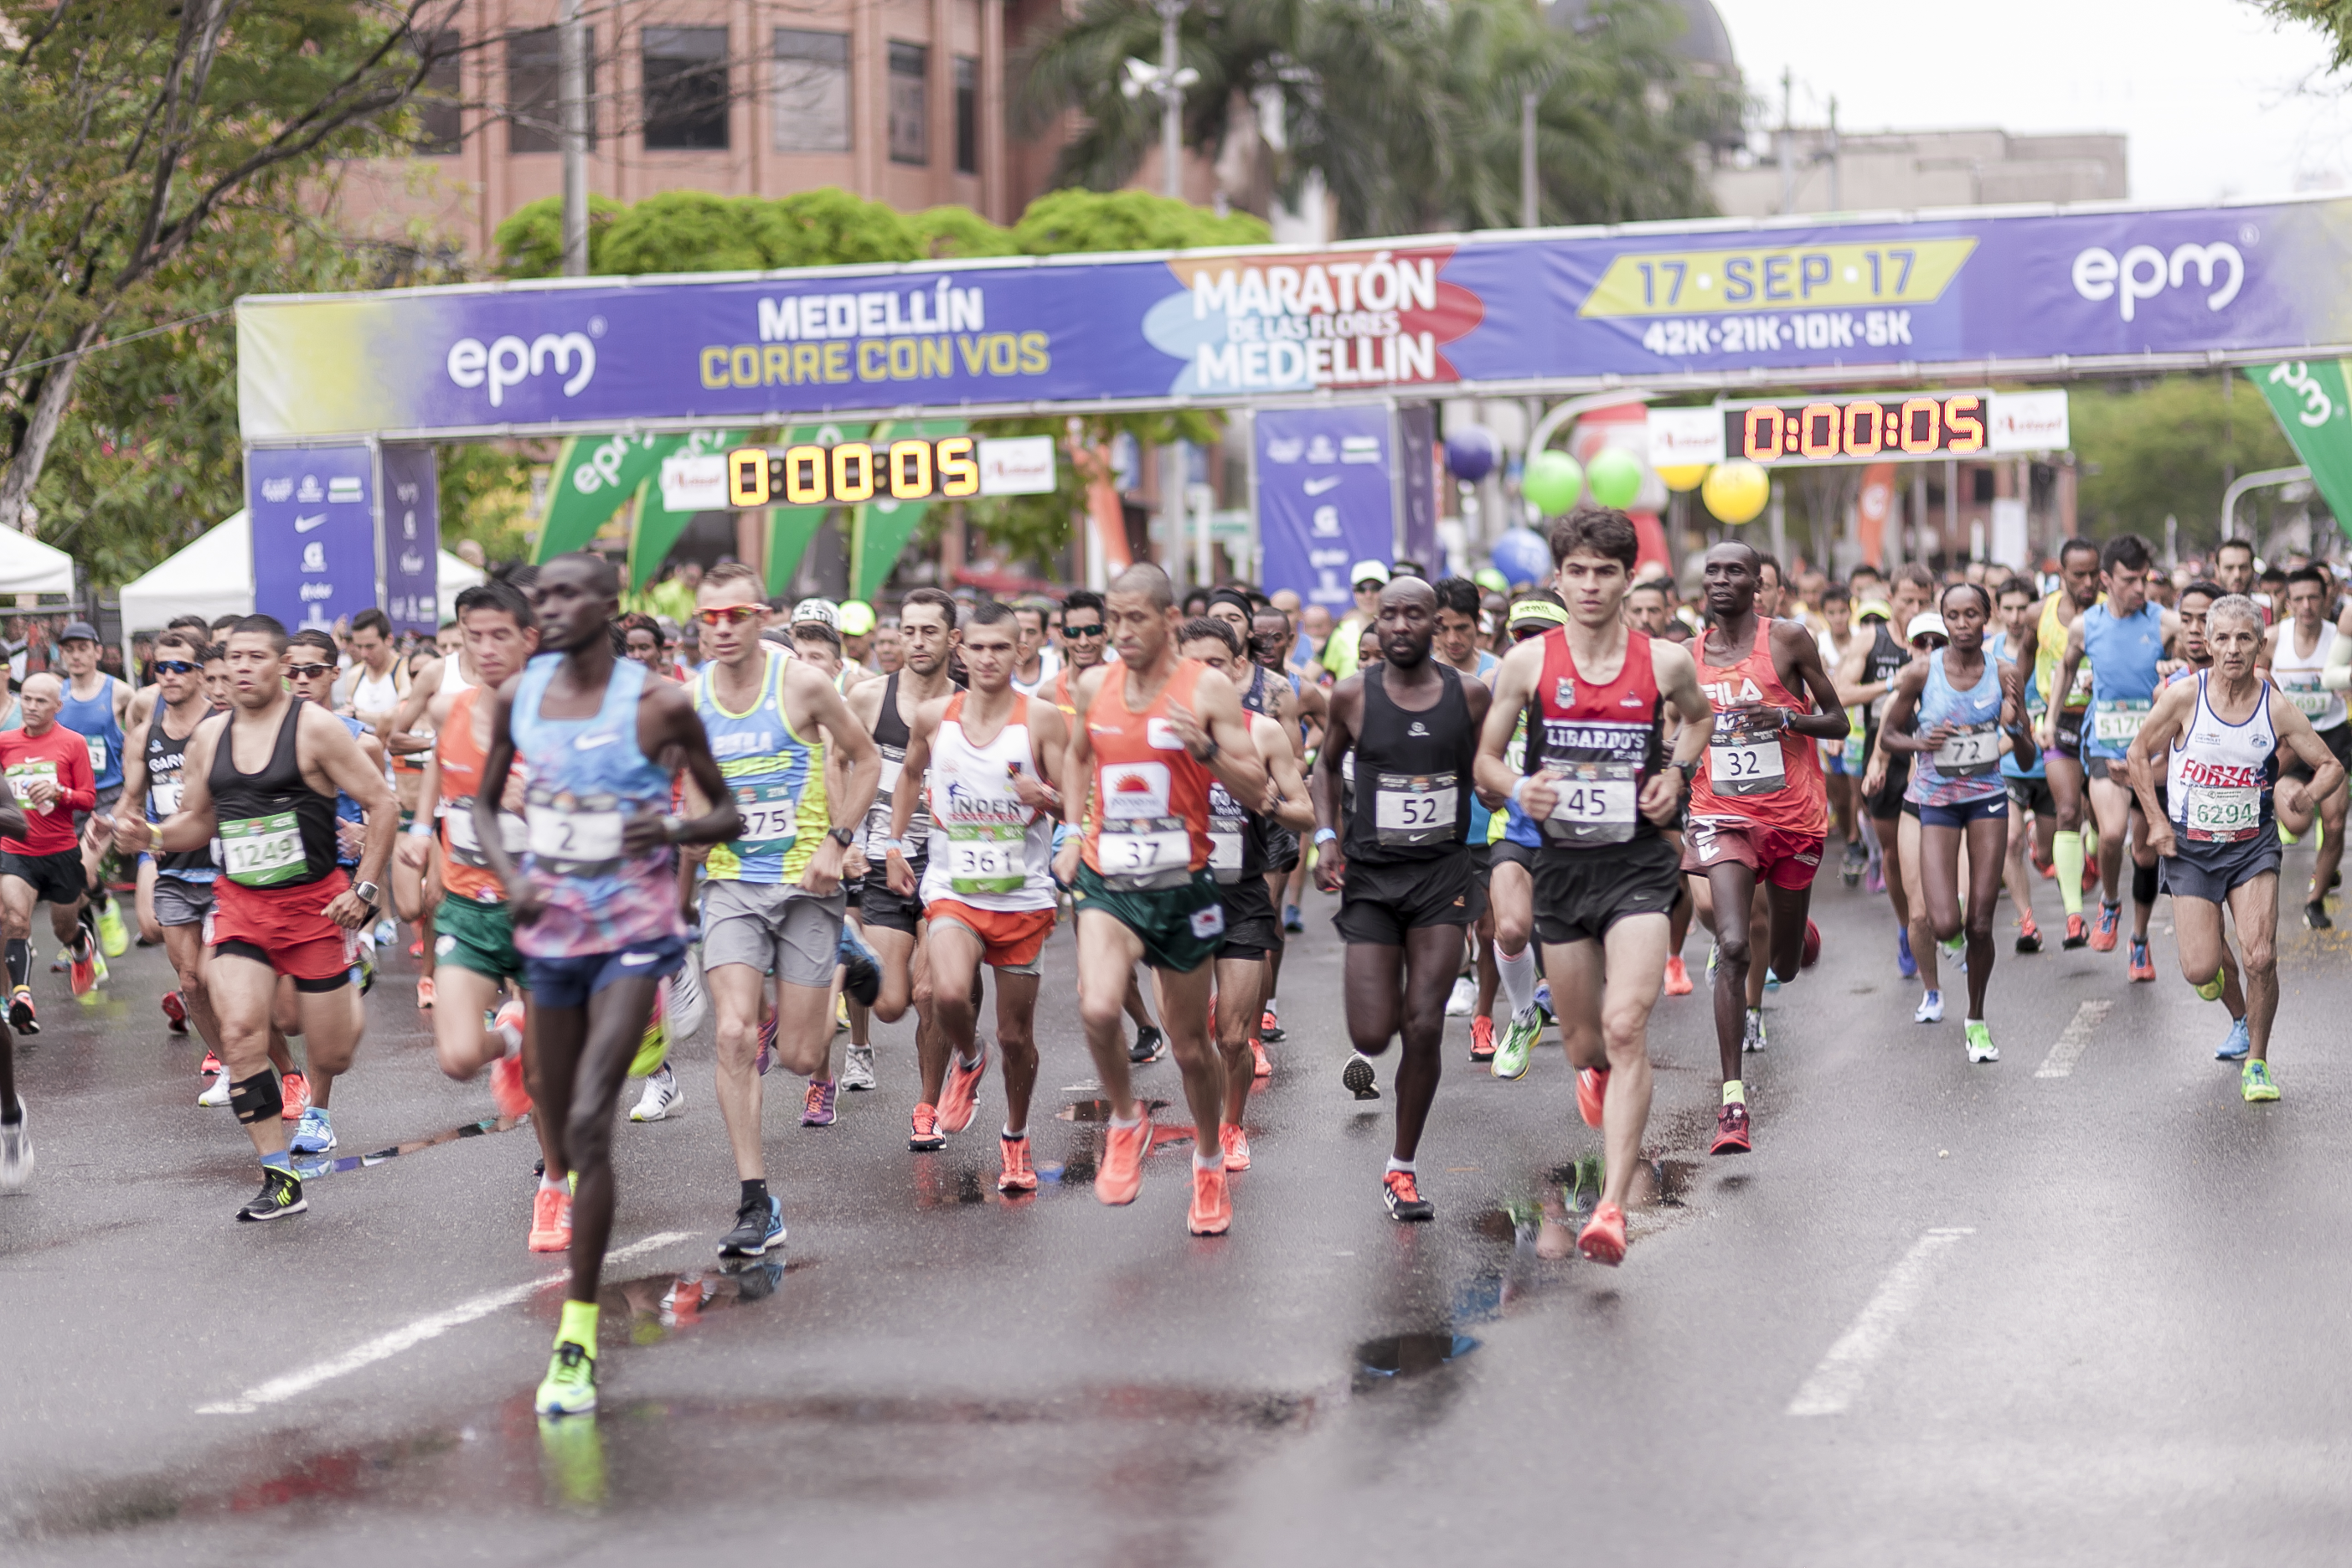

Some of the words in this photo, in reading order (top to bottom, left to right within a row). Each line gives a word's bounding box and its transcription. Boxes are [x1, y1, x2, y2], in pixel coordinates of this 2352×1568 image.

[1193, 251, 1436, 321] MARATÓN
[2072, 242, 2244, 322] epm
[757, 276, 985, 341] MEDELLÍN
[1227, 316, 1262, 343] DE
[1263, 314, 1308, 341] LAS
[1309, 310, 1400, 338] FLORES
[447, 331, 597, 408] epm
[700, 342, 853, 390] CORRE
[857, 336, 952, 382] CON
[958, 331, 1051, 377] VOS
[2269, 361, 2332, 428] pm
[1744, 395, 1984, 462] 0:00:05
[729, 437, 978, 507] 0:00:05
[1701, 677, 1763, 706] FILA
[1547, 729, 1645, 749] LIBARDO'S
[1951, 741, 1981, 761] 72
[1728, 751, 1760, 776] 32
[1403, 798, 1436, 824] 52
[1568, 789, 1605, 815] 45
[2197, 803, 2253, 824] 6294
[233, 836, 295, 867] 1249
[558, 823, 576, 851] 2
[962, 851, 1011, 872] 361
[1126, 842, 1159, 867] 37
